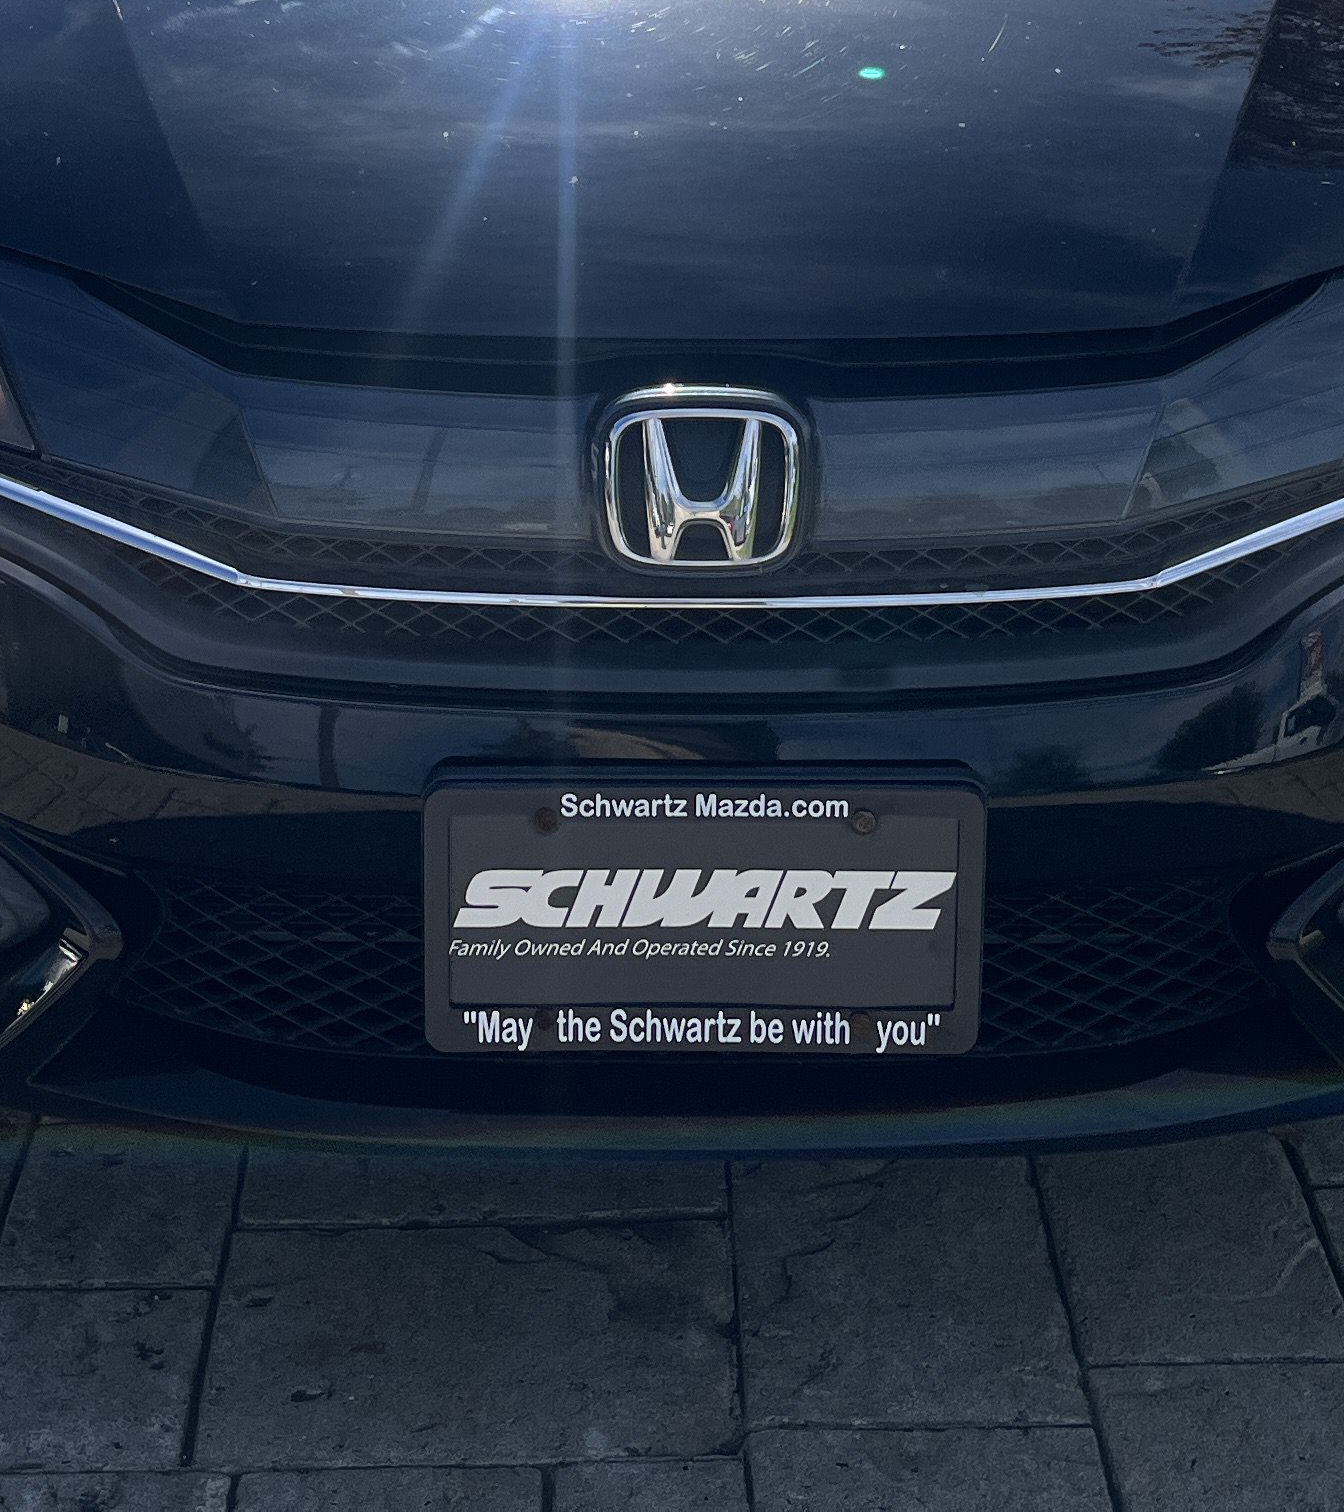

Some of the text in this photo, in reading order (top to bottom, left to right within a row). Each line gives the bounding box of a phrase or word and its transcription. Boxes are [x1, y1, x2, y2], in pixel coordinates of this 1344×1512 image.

[560, 793, 849, 818] Schwartz Mazda.com
[453, 868, 957, 930] SCHWARTZ
[448, 939, 831, 960] Family Owned And Operated Since 1919.
[463, 1009, 941, 1054] "May the Schwartz be with you"
